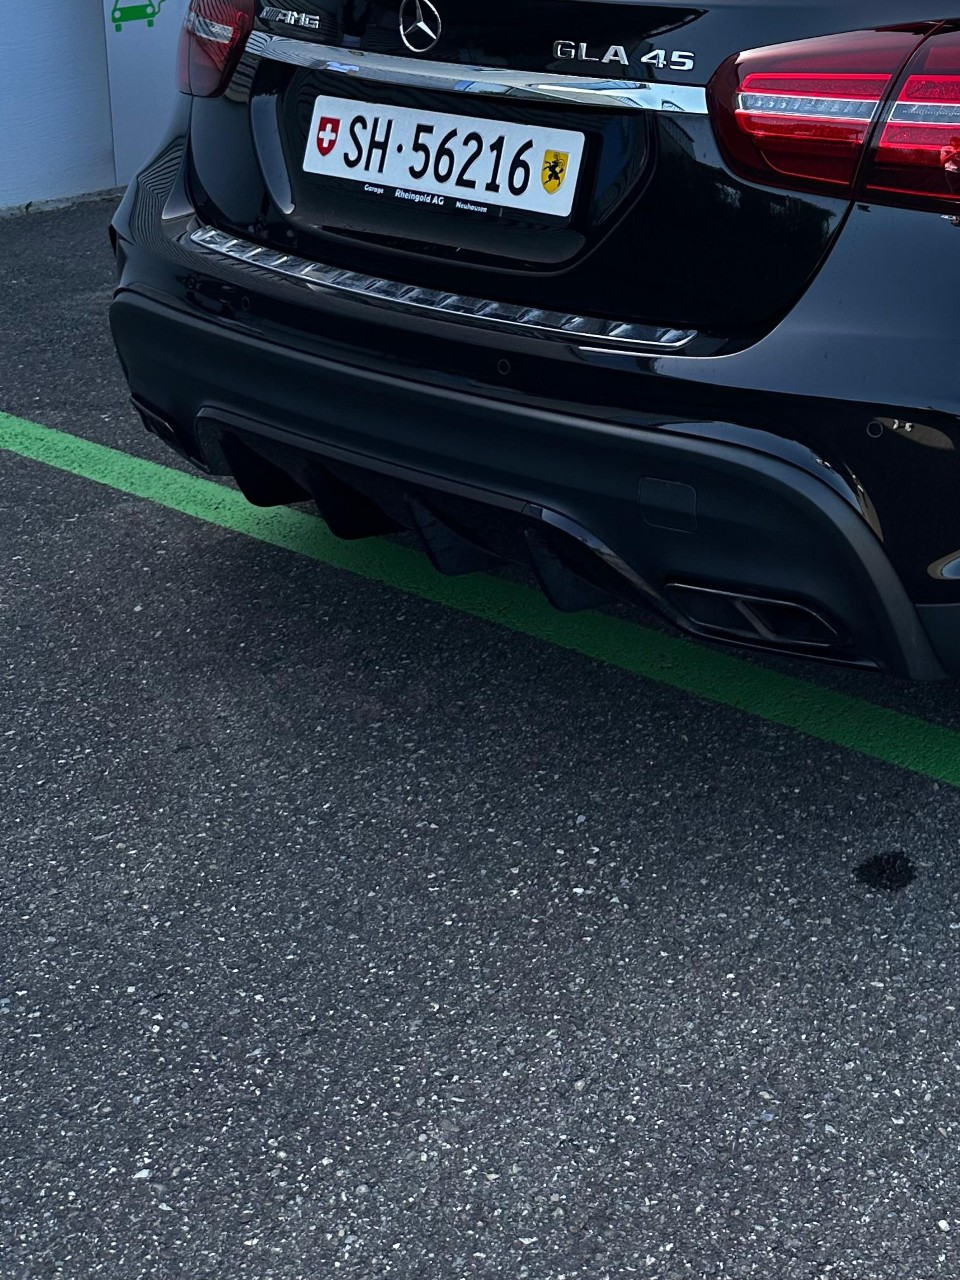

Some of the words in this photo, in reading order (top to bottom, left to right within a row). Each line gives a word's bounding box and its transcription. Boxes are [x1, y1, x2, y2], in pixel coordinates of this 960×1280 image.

[275, 8, 320, 29] AMG
[552, 40, 629, 66] GLA
[640, 49, 695, 71] 45
[364, 184, 384, 195] Garage
[395, 188, 431, 203] Rheingold
[431, 195, 445, 205] AG
[455, 200, 488, 213] Neuhausen
